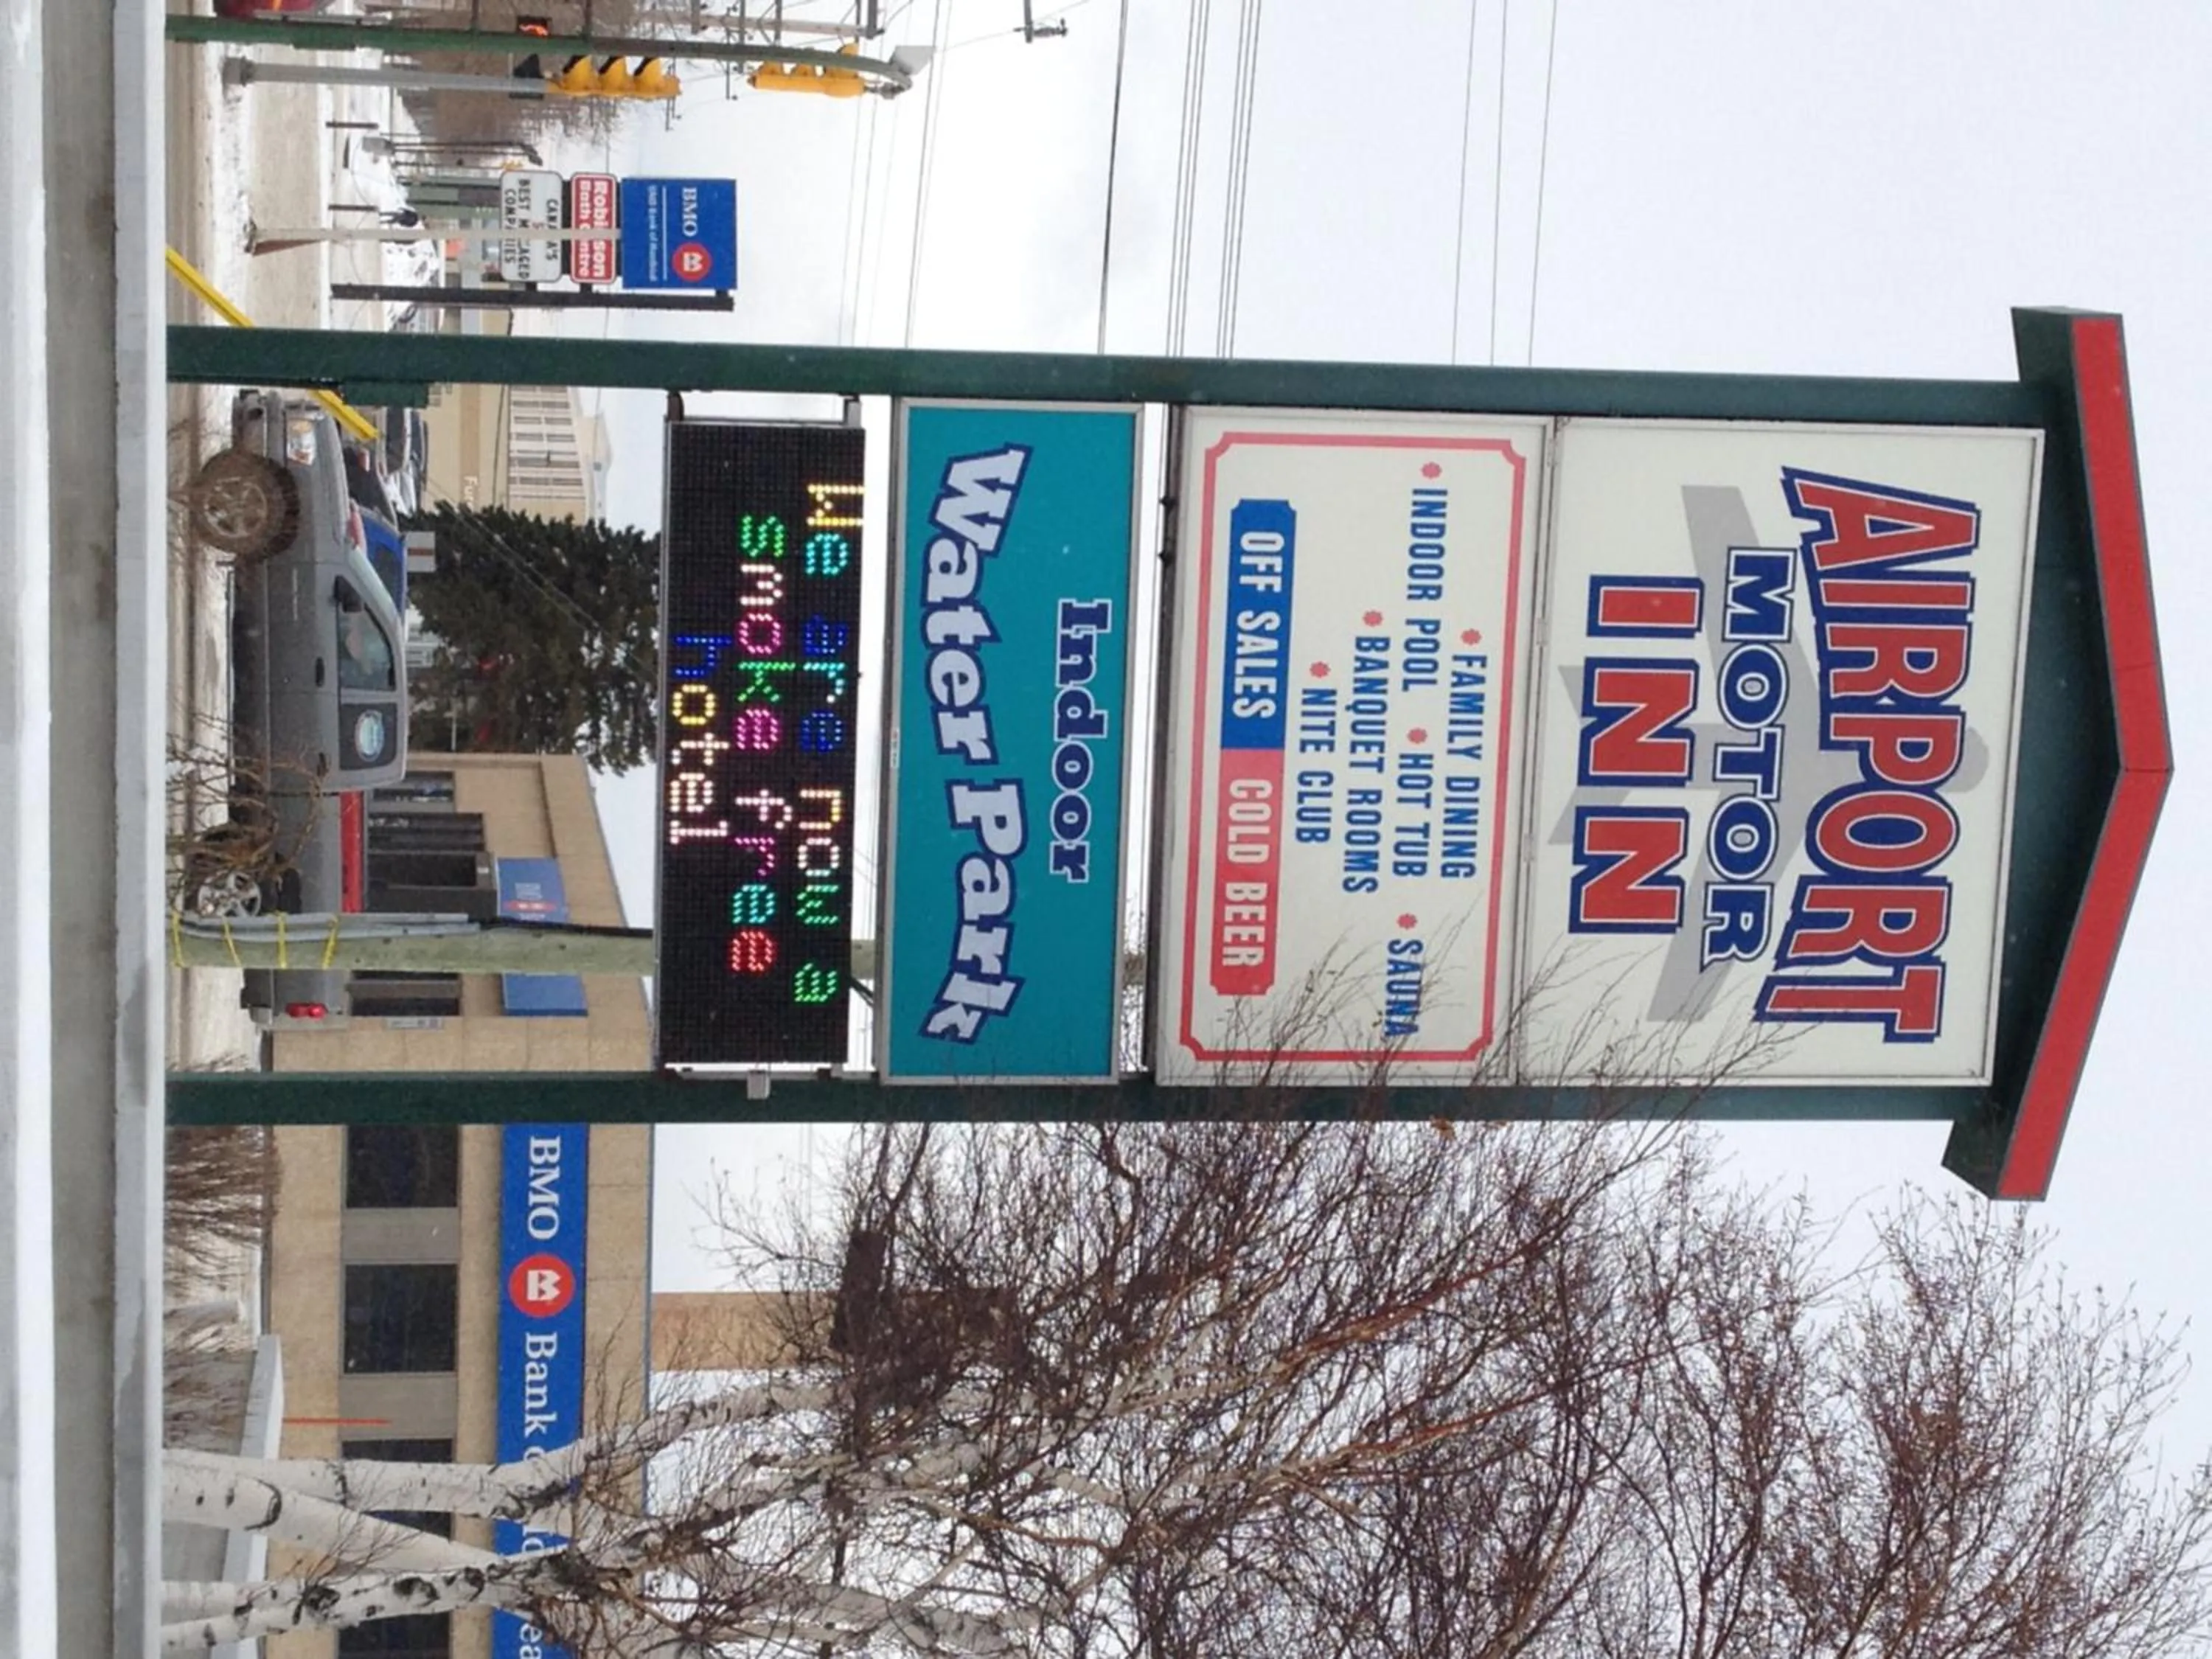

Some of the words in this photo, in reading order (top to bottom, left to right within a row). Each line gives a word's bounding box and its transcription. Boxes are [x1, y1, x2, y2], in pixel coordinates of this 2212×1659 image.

[518, 178, 531, 211] BEST
[546, 199, 559, 261] CANAA'S
[593, 180, 608, 277] Robison
[682, 187, 698, 237] BMO
[518, 219, 531, 280] MAGED
[580, 223, 590, 277] Cntre
[804, 481, 865, 576] We
[1237, 530, 1285, 593] OFF
[1407, 488, 1447, 601] INDOOR
[736, 514, 796, 752] smoke
[920, 444, 1033, 766] Water
[1402, 618, 1441, 692] POOL
[801, 616, 849, 753] are
[1233, 611, 1281, 720] SALES
[1345, 636, 1390, 773] BANQUET
[1445, 654, 1487, 761] FAMILY
[668, 634, 732, 846] hotel
[1048, 597, 1113, 883] Indoor
[1298, 688, 1337, 754] NITE
[1569, 575, 1704, 934] INN
[1700, 547, 1797, 973] MOTOR
[1753, 467, 1982, 1043] AIRPORT
[1225, 778, 1274, 864] COLD
[1295, 770, 1333, 844] CLUB
[1394, 752, 1434, 809] HOT
[1440, 776, 1482, 880] DINING
[731, 788, 793, 974] free
[795, 788, 844, 928] now
[1342, 790, 1382, 894] ROOMS
[1392, 823, 1431, 877] TUB
[919, 779, 1029, 1044] Park
[1221, 881, 1268, 967] BEER
[793, 962, 838, 1004] a
[1384, 939, 1424, 1037] SAUNA
[526, 1135, 560, 1240] BMO
[523, 1331, 557, 1438] Bank
